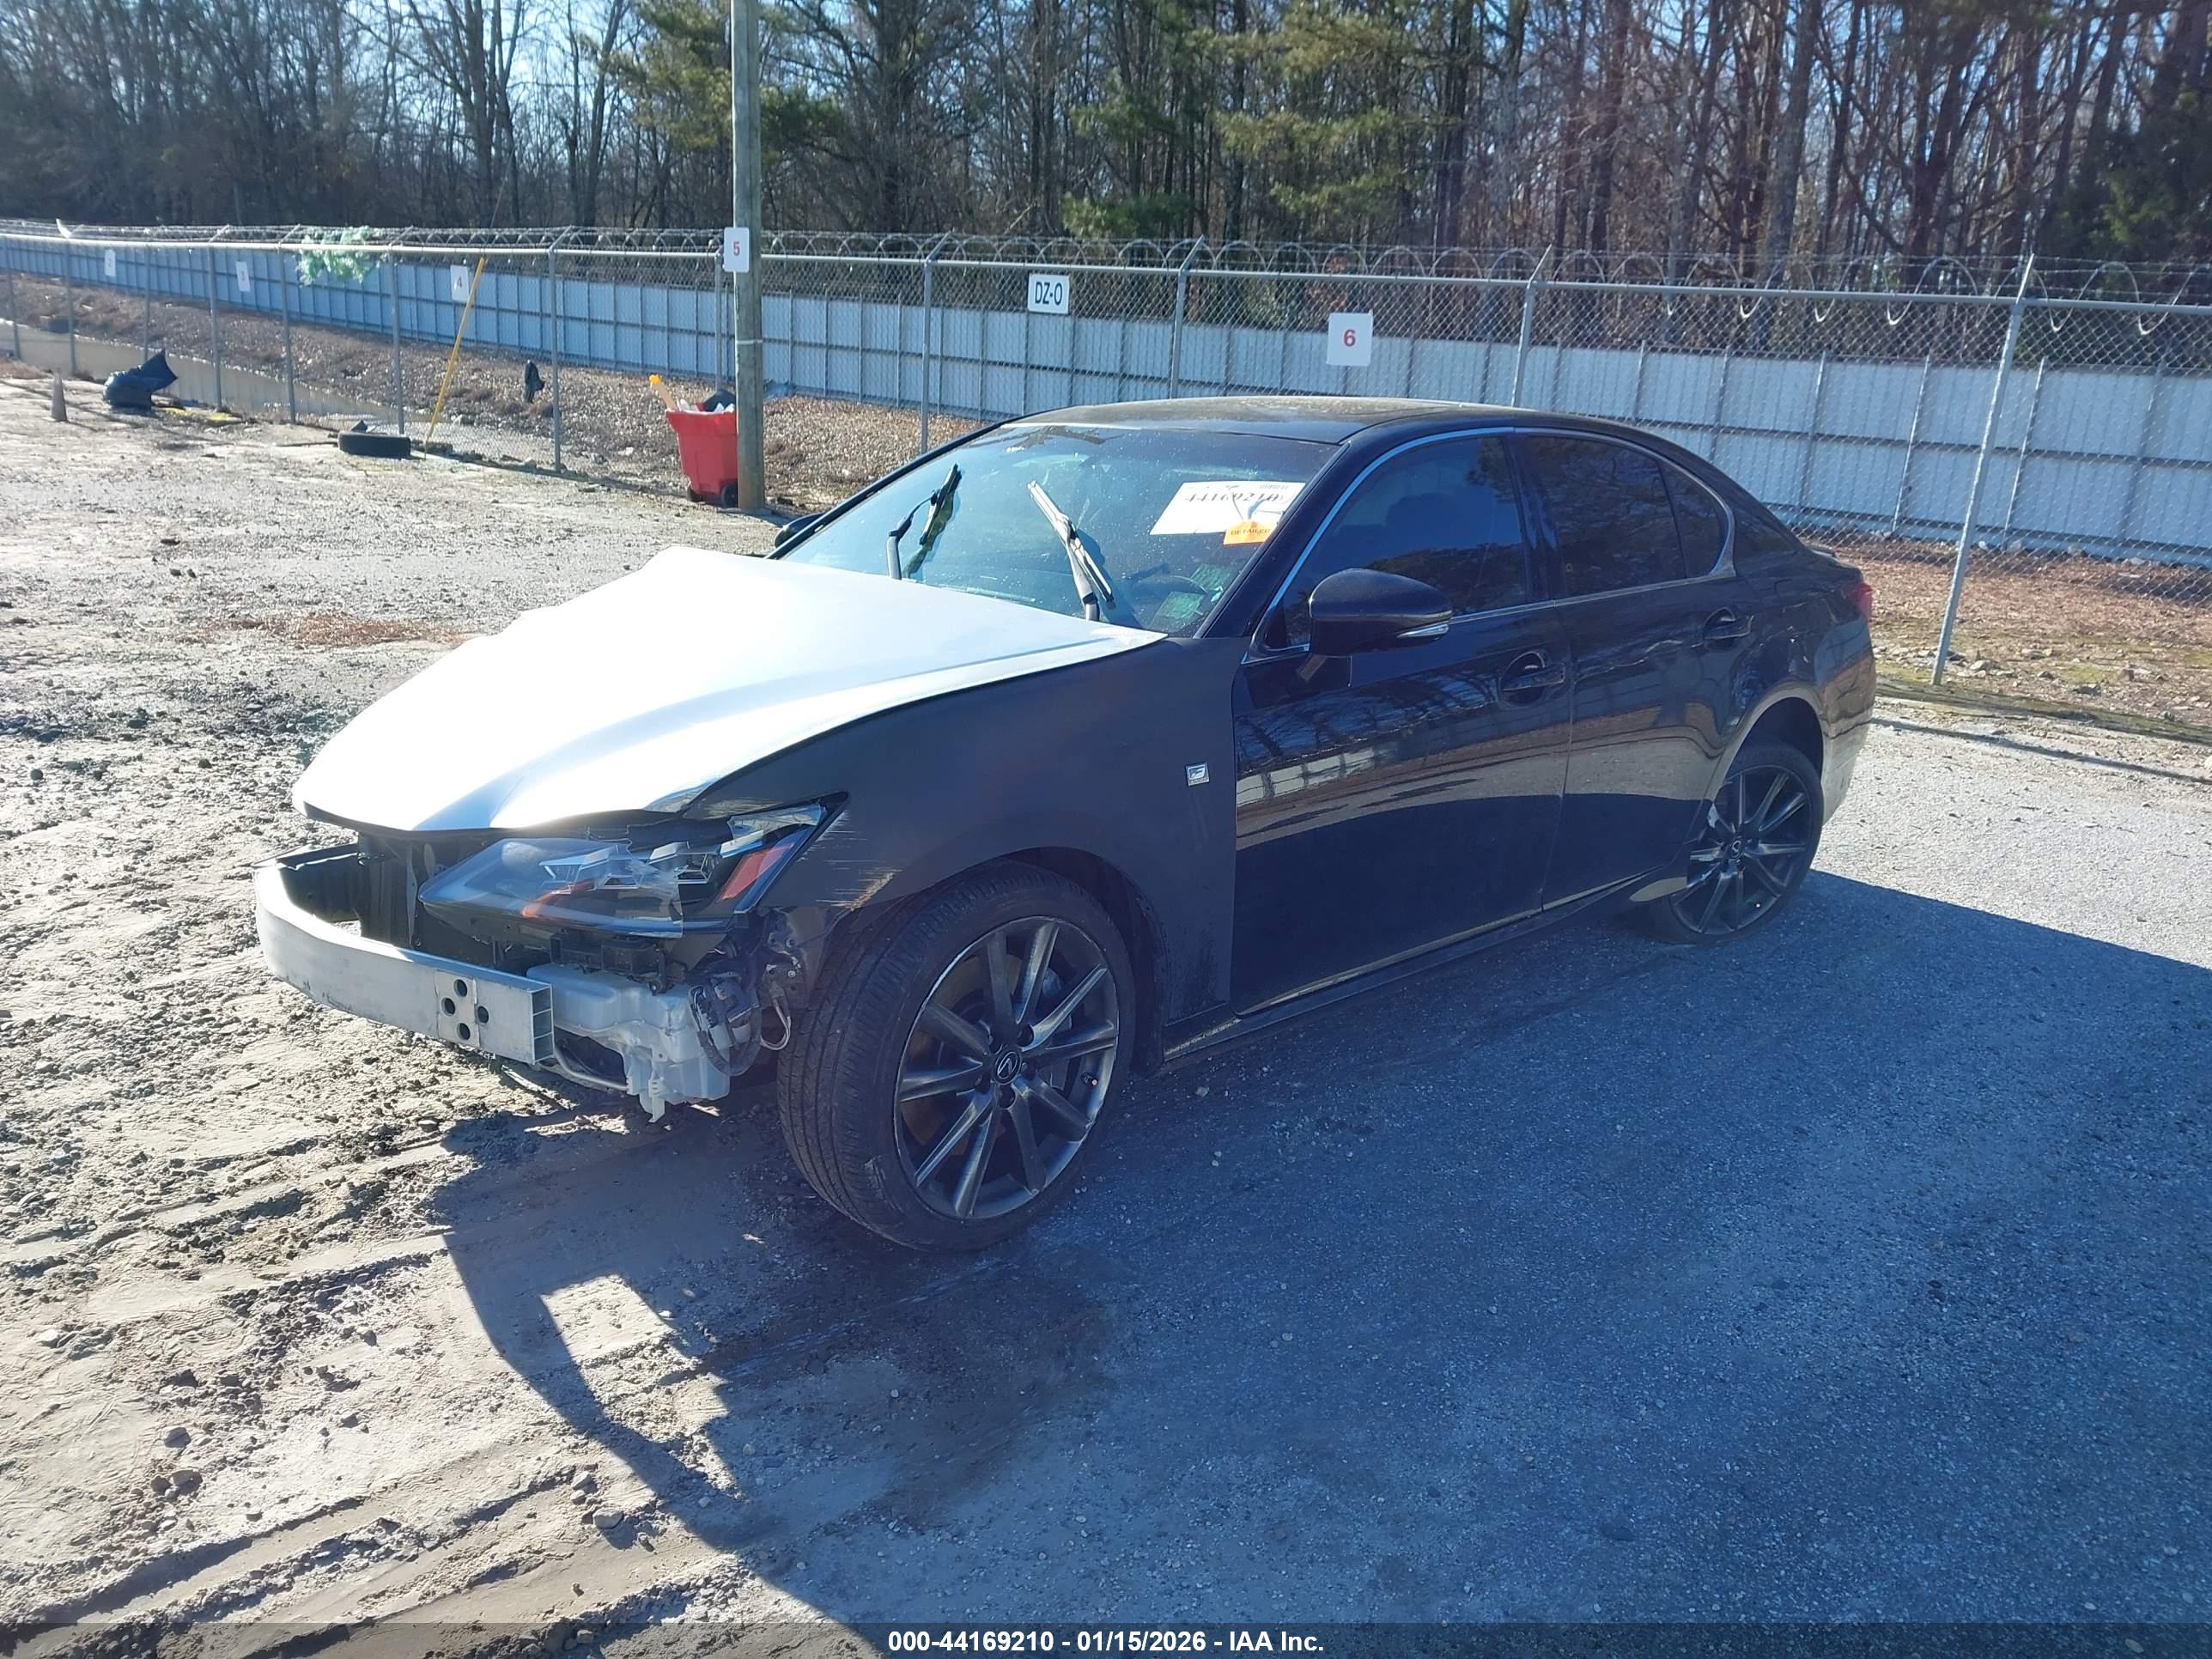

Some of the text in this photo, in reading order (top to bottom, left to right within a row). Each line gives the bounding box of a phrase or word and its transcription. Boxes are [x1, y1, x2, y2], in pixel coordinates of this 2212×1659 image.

[733, 241, 740, 257] 5
[456, 276, 463, 289] 4
[1344, 329, 1356, 347] 6
